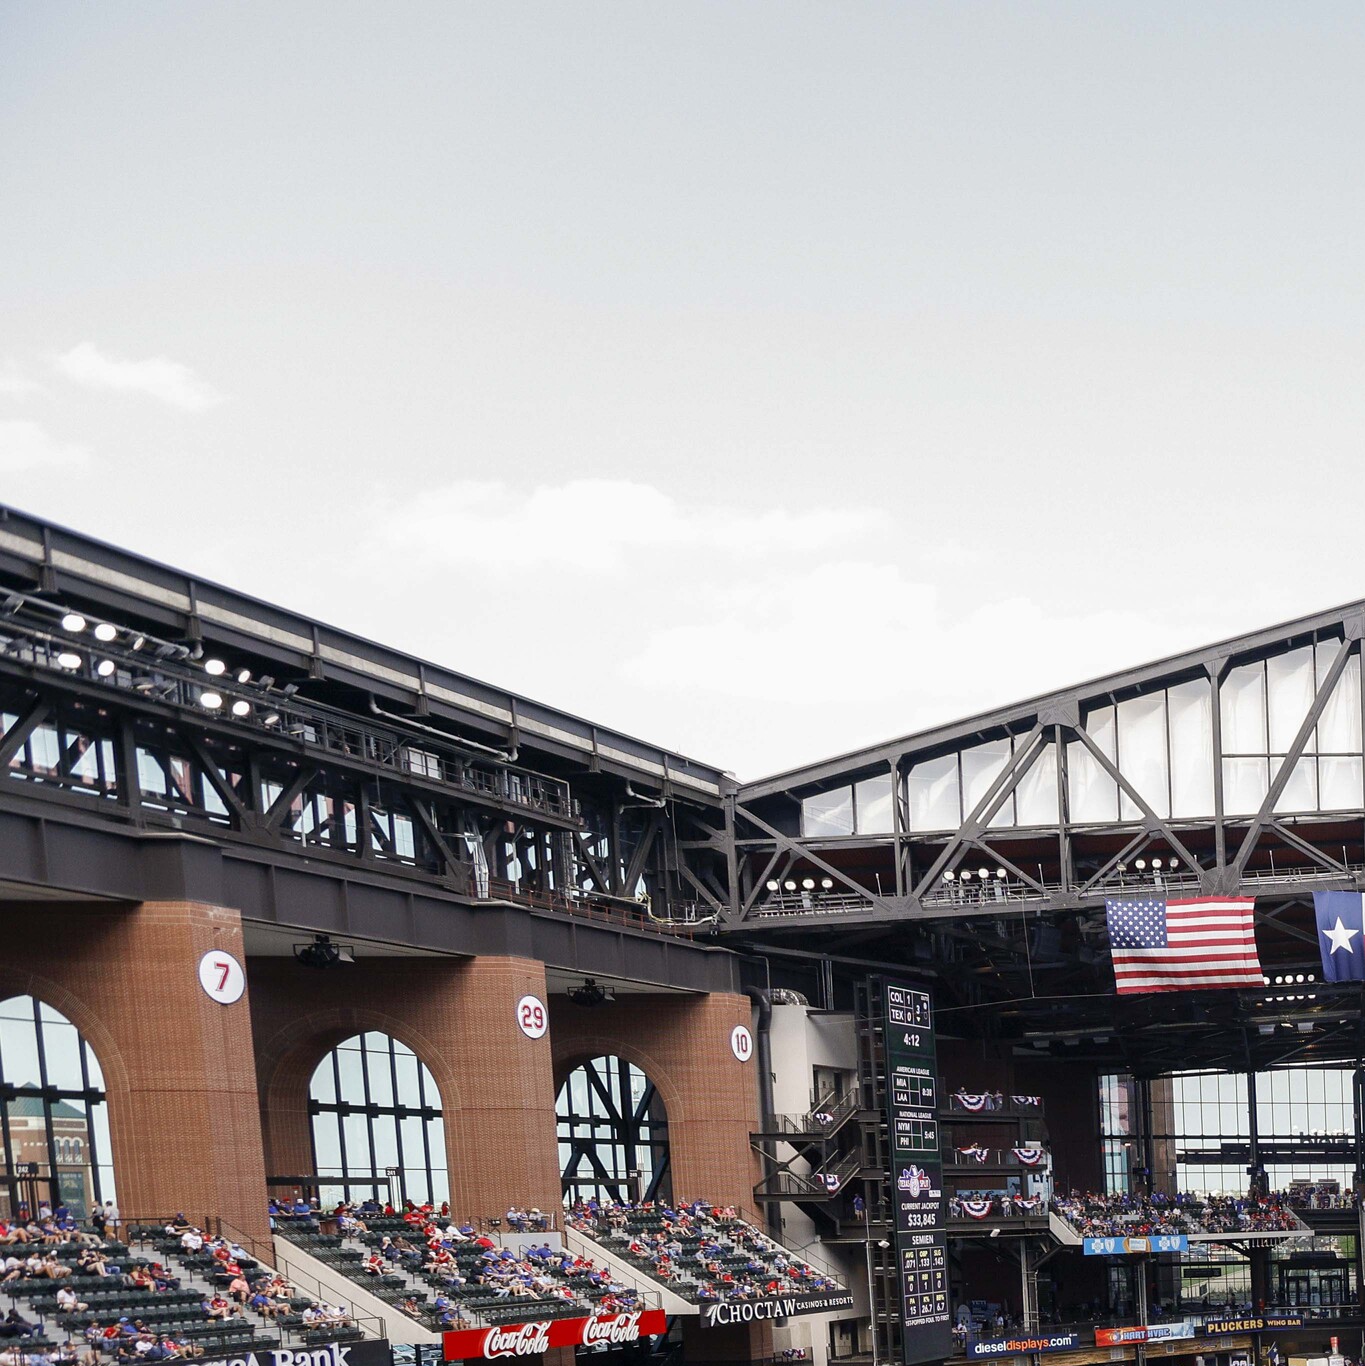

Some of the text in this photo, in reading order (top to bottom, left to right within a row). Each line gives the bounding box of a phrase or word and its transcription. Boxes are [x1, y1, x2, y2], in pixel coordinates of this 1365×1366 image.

[214, 962, 230, 992] 7
[890, 992, 904, 1003] COL
[906, 995, 911, 1005] 1
[521, 1005, 544, 1029] 29
[734, 1033, 748, 1054] 10
[903, 1033, 920, 1047] 4:12
[901, 1202, 940, 1211] CURRENT JACKPOT
[907, 1213, 936, 1227] $33,845
[912, 1235, 934, 1245] SEMIEN
[582, 1312, 642, 1347] Coca-Cola
[1208, 1319, 1264, 1333] PLUCKERS
[483, 1321, 552, 1360] Coca-Cola
[1123, 1328, 1170, 1340] HART HVAC
[975, 1336, 1072, 1354] dieseldisplays.com
